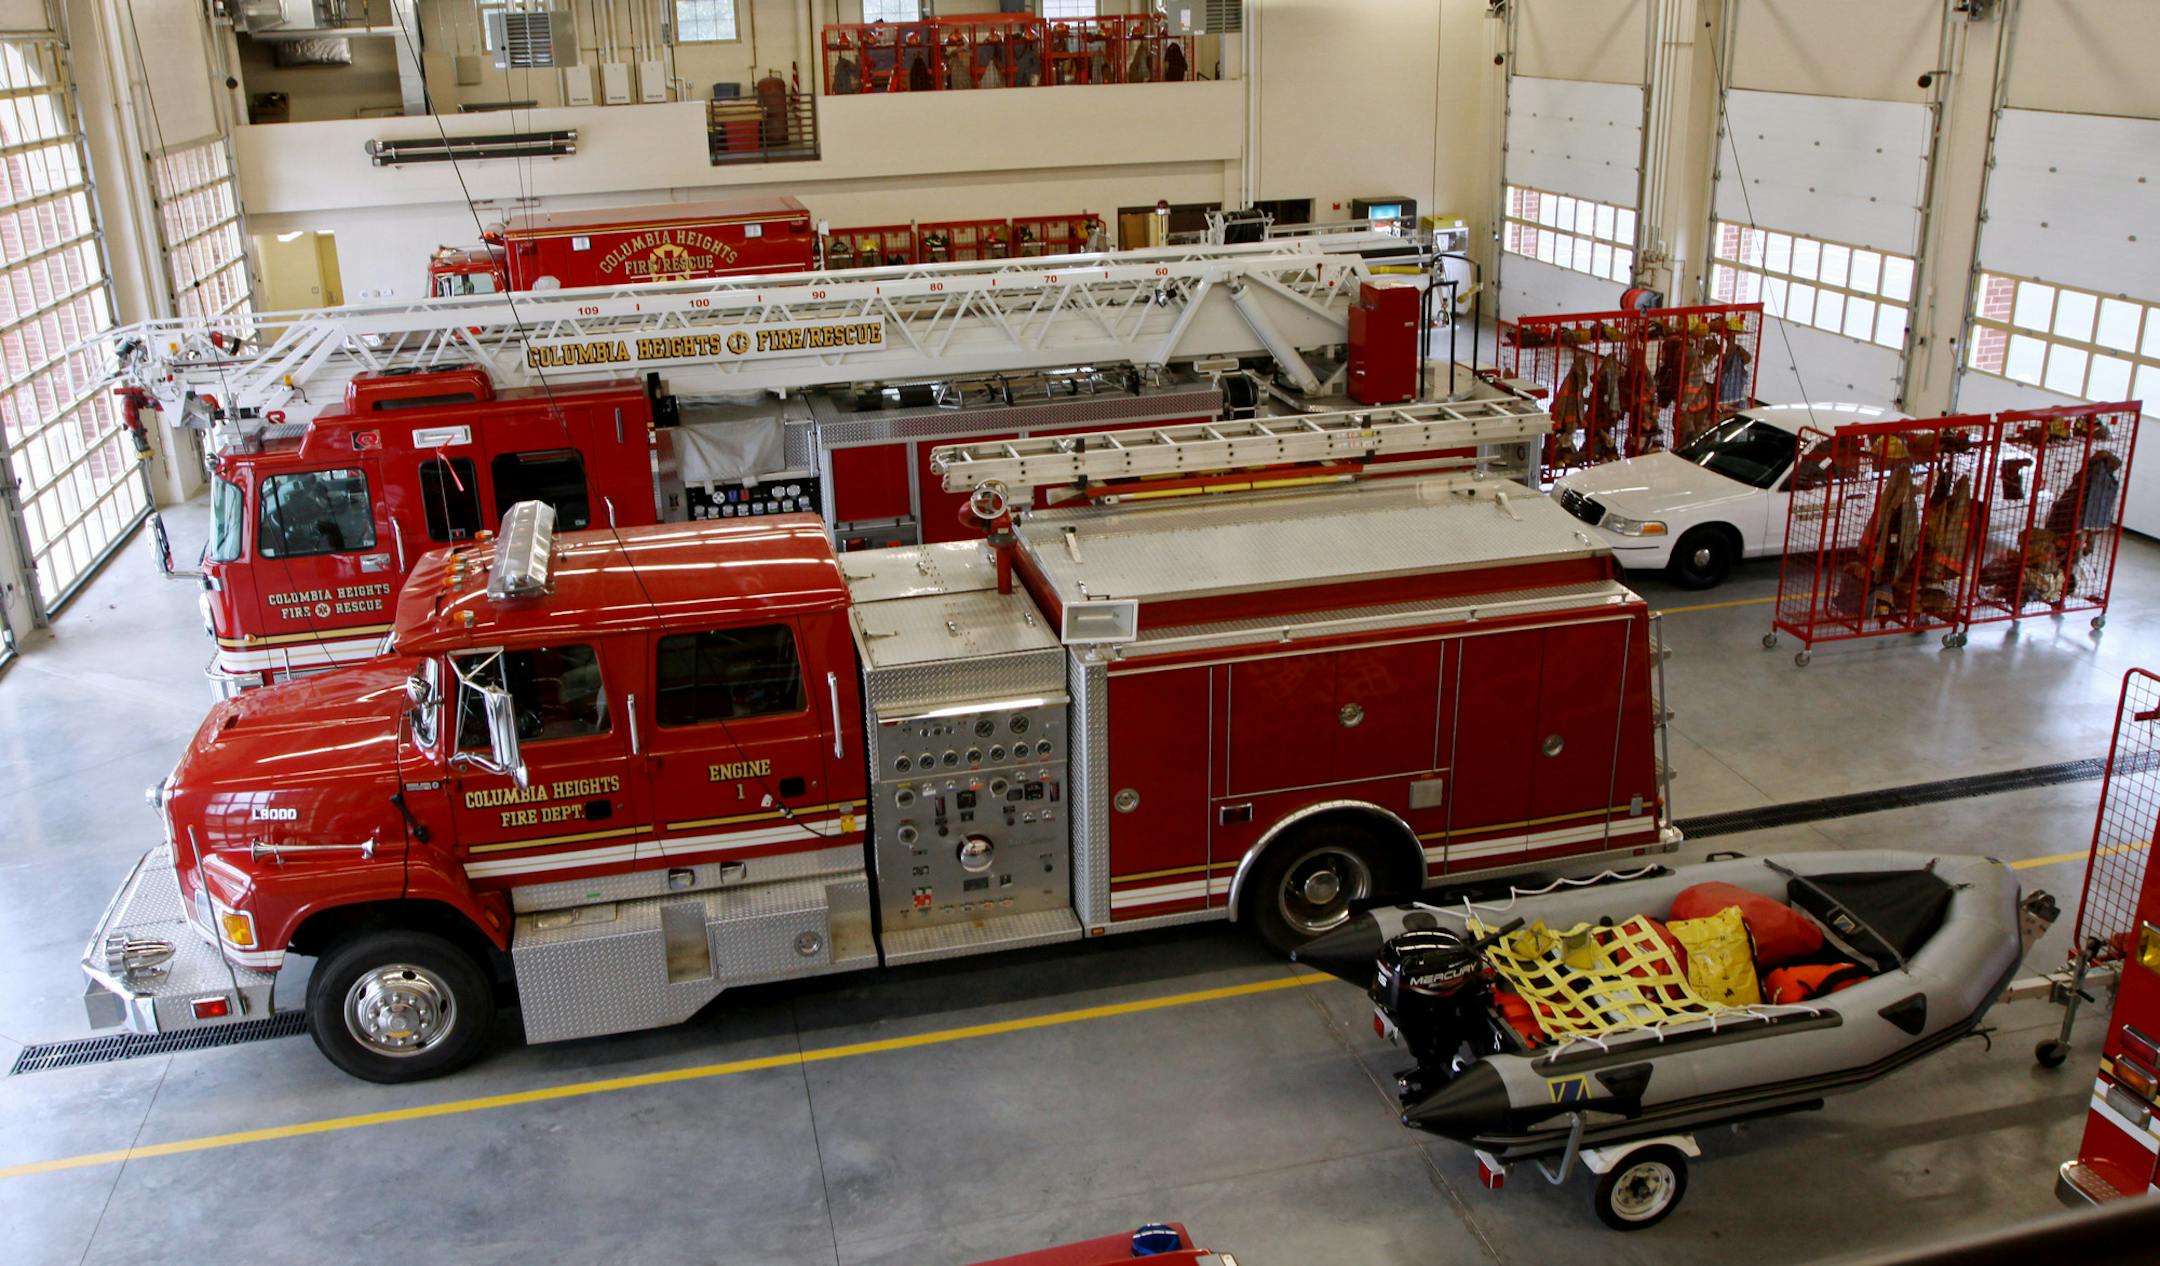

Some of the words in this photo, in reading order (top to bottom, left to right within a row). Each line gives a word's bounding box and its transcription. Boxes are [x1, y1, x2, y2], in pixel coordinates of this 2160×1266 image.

[599, 230, 671, 274] COLUMBIA
[676, 229, 738, 264] HEIGHTS
[1044, 274, 1058, 284] 70
[1155, 267, 1168, 277] 60
[812, 290, 826, 299] 90
[929, 282, 944, 292] 80
[578, 306, 599, 316] 109
[688, 298, 710, 308] 100
[528, 340, 631, 369] COLUMBIA
[636, 333, 721, 361] HEIGHTS
[756, 322, 882, 352] FIRE/RESCUE
[268, 589, 333, 605] COLUMBIA
[336, 583, 390, 599] HEIGHTS
[281, 605, 311, 620] FIRE
[335, 599, 383, 614] RESCUE
[708, 759, 771, 782] ENGINE
[465, 784, 549, 809] COLUMBIA
[552, 775, 620, 799] HEIGHTS
[501, 809, 538, 828] FIRE
[542, 804, 585, 823] DEPT.
[1409, 962, 1478, 986] MERCURY
